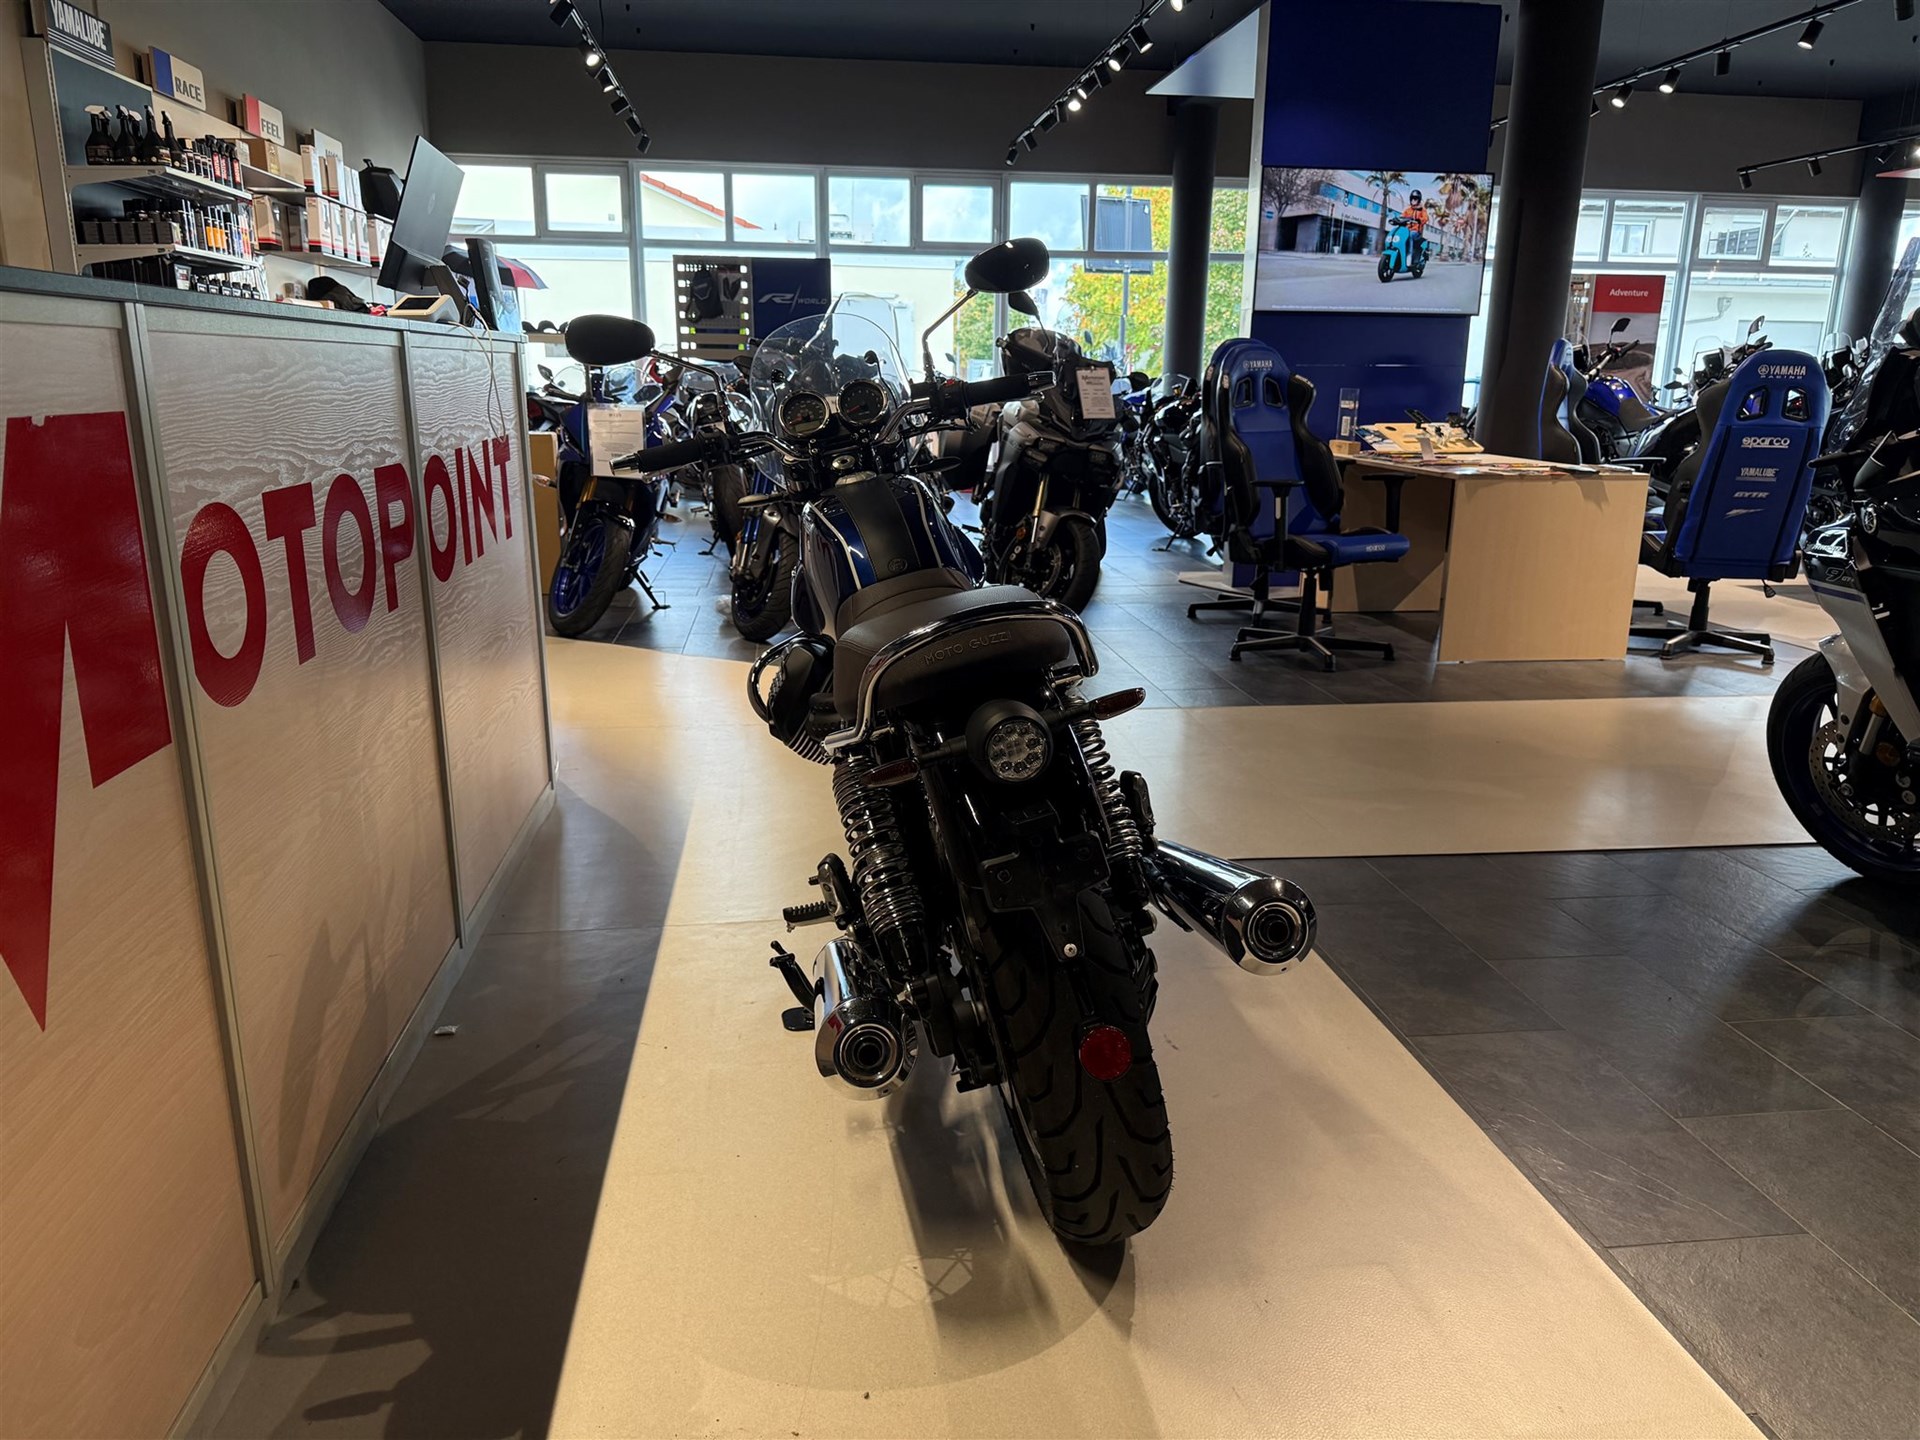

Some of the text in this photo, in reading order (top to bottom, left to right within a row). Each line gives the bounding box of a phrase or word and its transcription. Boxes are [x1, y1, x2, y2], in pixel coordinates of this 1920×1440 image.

[51, 0, 106, 50] YAMALUBE
[174, 76, 202, 102] RACE
[261, 118, 281, 140] FEEL
[1609, 288, 1649, 297] Adventure
[1250, 360, 1273, 368] YAMAHA
[1770, 365, 1807, 376] YAMAHA
[1742, 436, 1790, 449] sparco
[1740, 467, 1777, 477] YAMALUBE
[924, 630, 1012, 665] MOTO GUZZI
